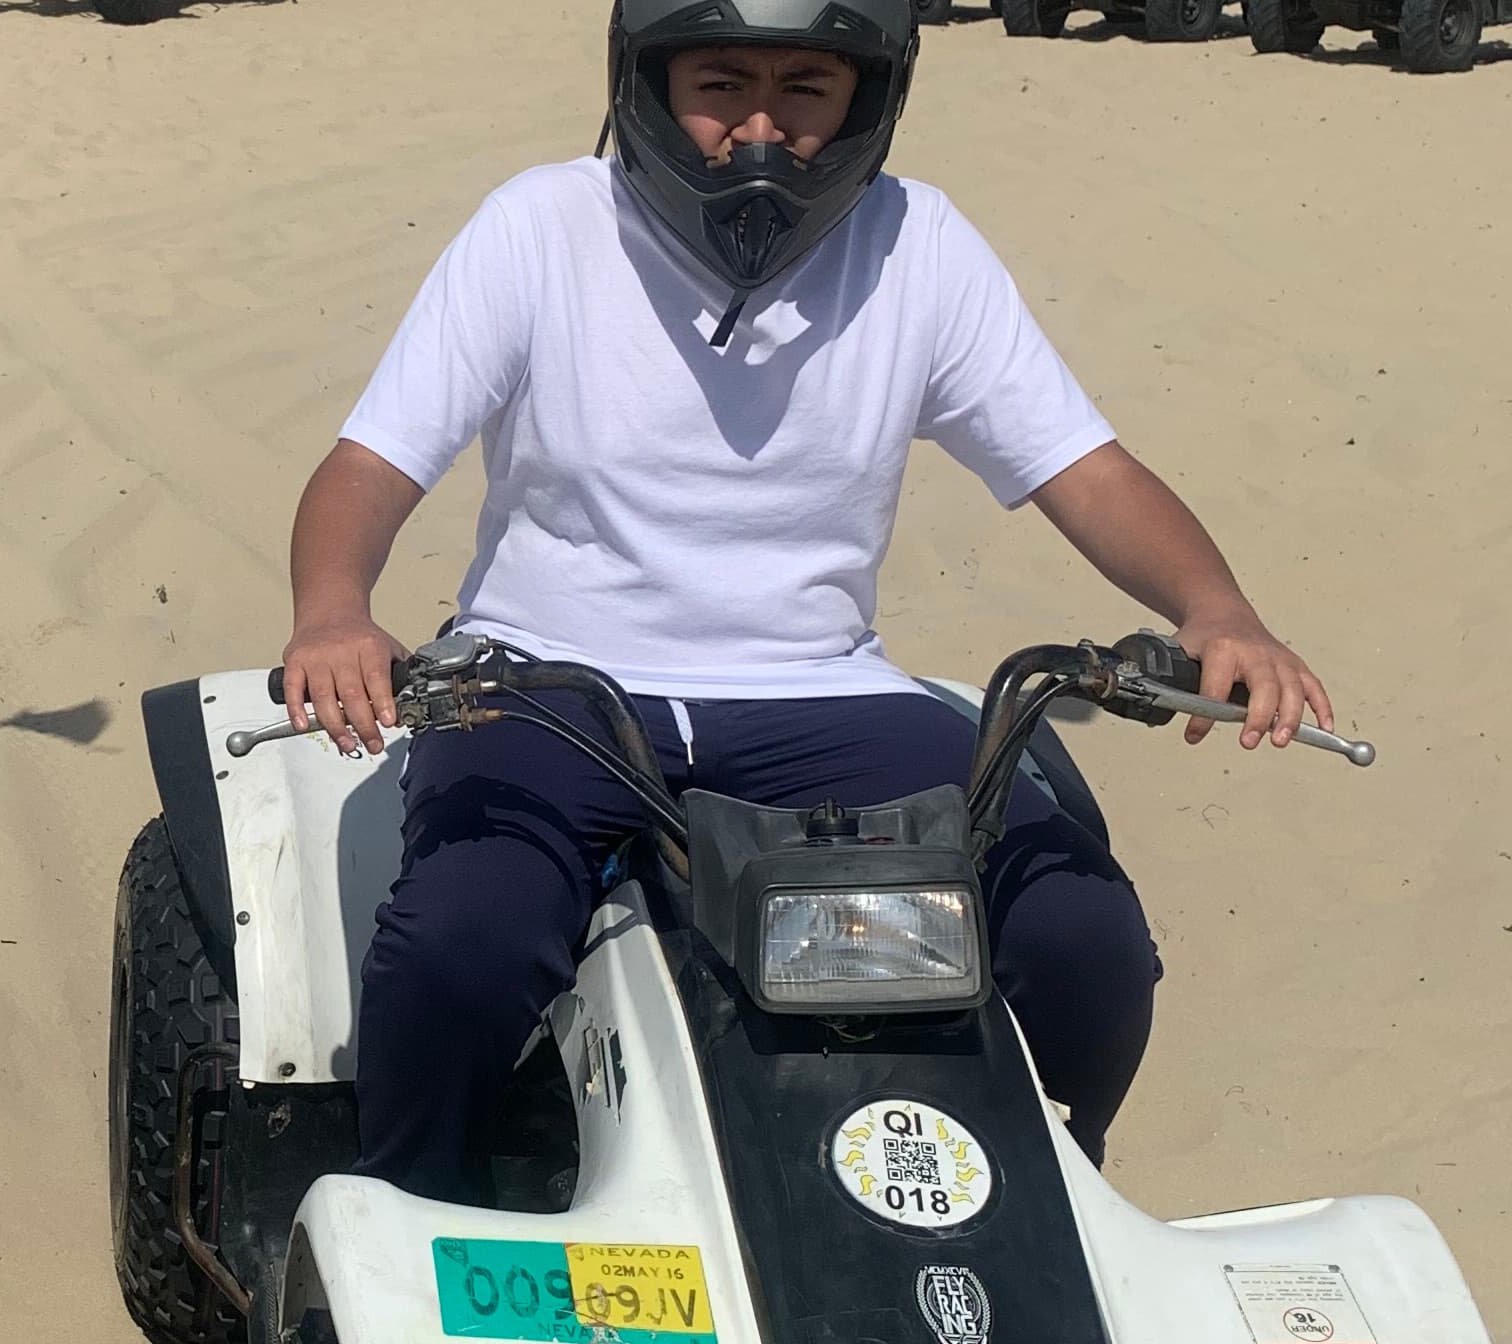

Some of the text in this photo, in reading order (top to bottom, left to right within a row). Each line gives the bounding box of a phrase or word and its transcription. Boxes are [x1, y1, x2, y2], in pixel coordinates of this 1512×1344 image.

[883, 1109, 924, 1137] QI
[885, 1185, 950, 1215] 018
[589, 1247, 690, 1260] NEVADA
[932, 1275, 965, 1295] FLY
